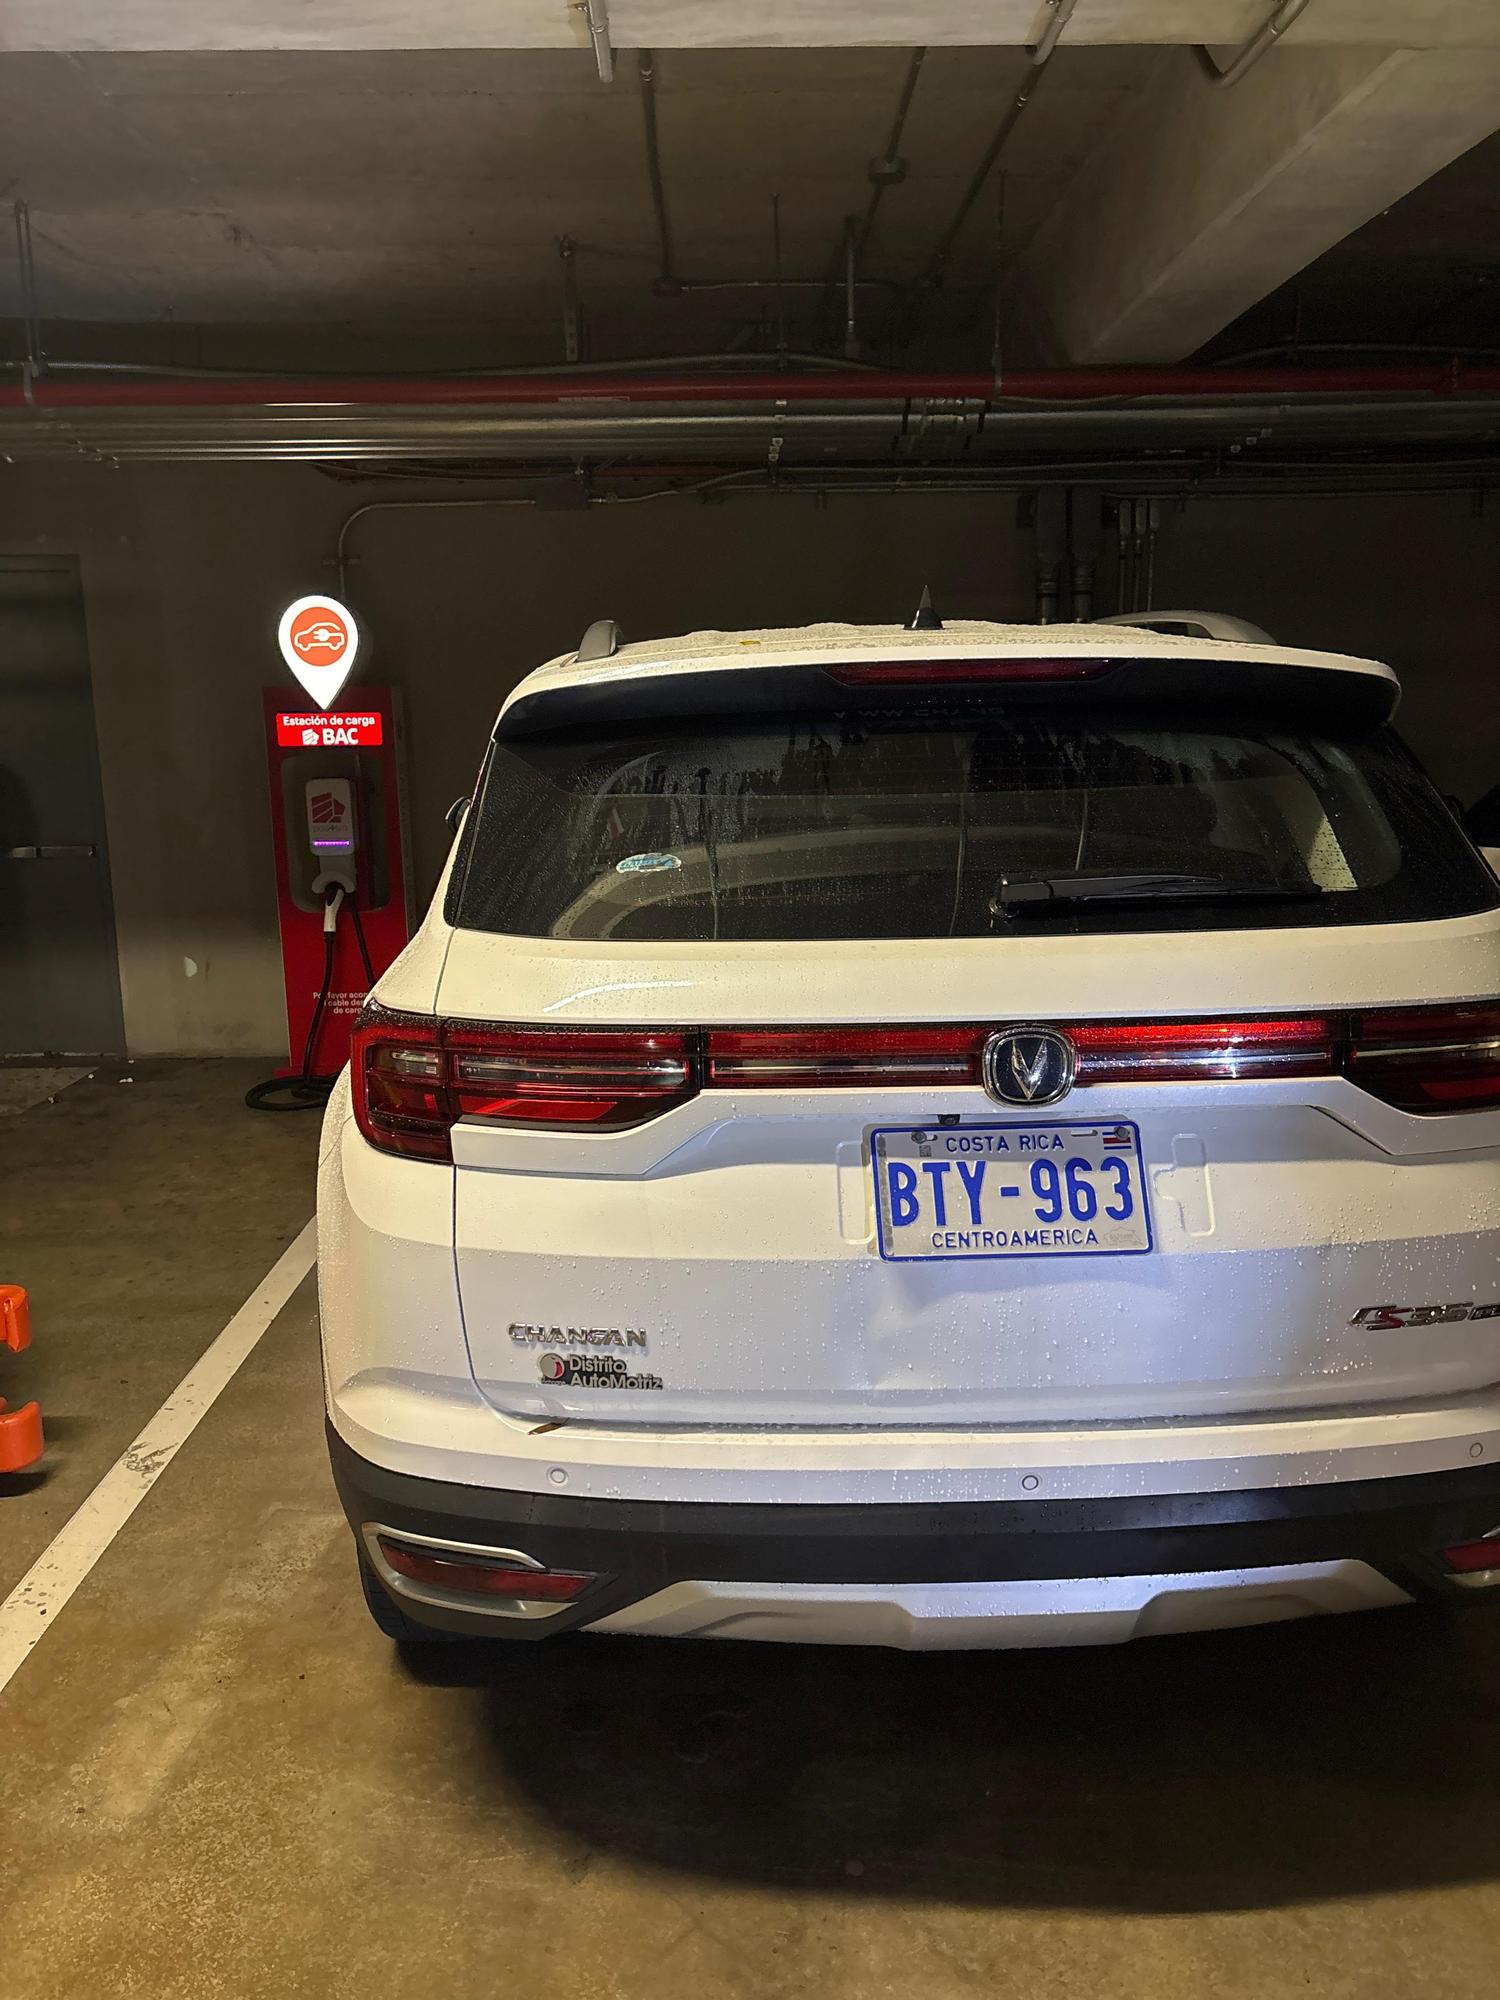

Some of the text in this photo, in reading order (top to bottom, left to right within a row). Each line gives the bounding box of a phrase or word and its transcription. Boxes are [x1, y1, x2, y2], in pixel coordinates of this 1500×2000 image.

[283, 715, 375, 727] Estación de carga
[322, 728, 358, 745] BAC
[328, 999, 349, 1007] cable
[945, 1134, 1065, 1154] COSTA RICA
[887, 1156, 1134, 1227] BTY-963
[931, 1228, 1098, 1250] CENTROAMERICA
[508, 1322, 647, 1346] CHANGAN
[569, 1354, 627, 1373] Distrito
[570, 1372, 663, 1390] AutoMotriz
